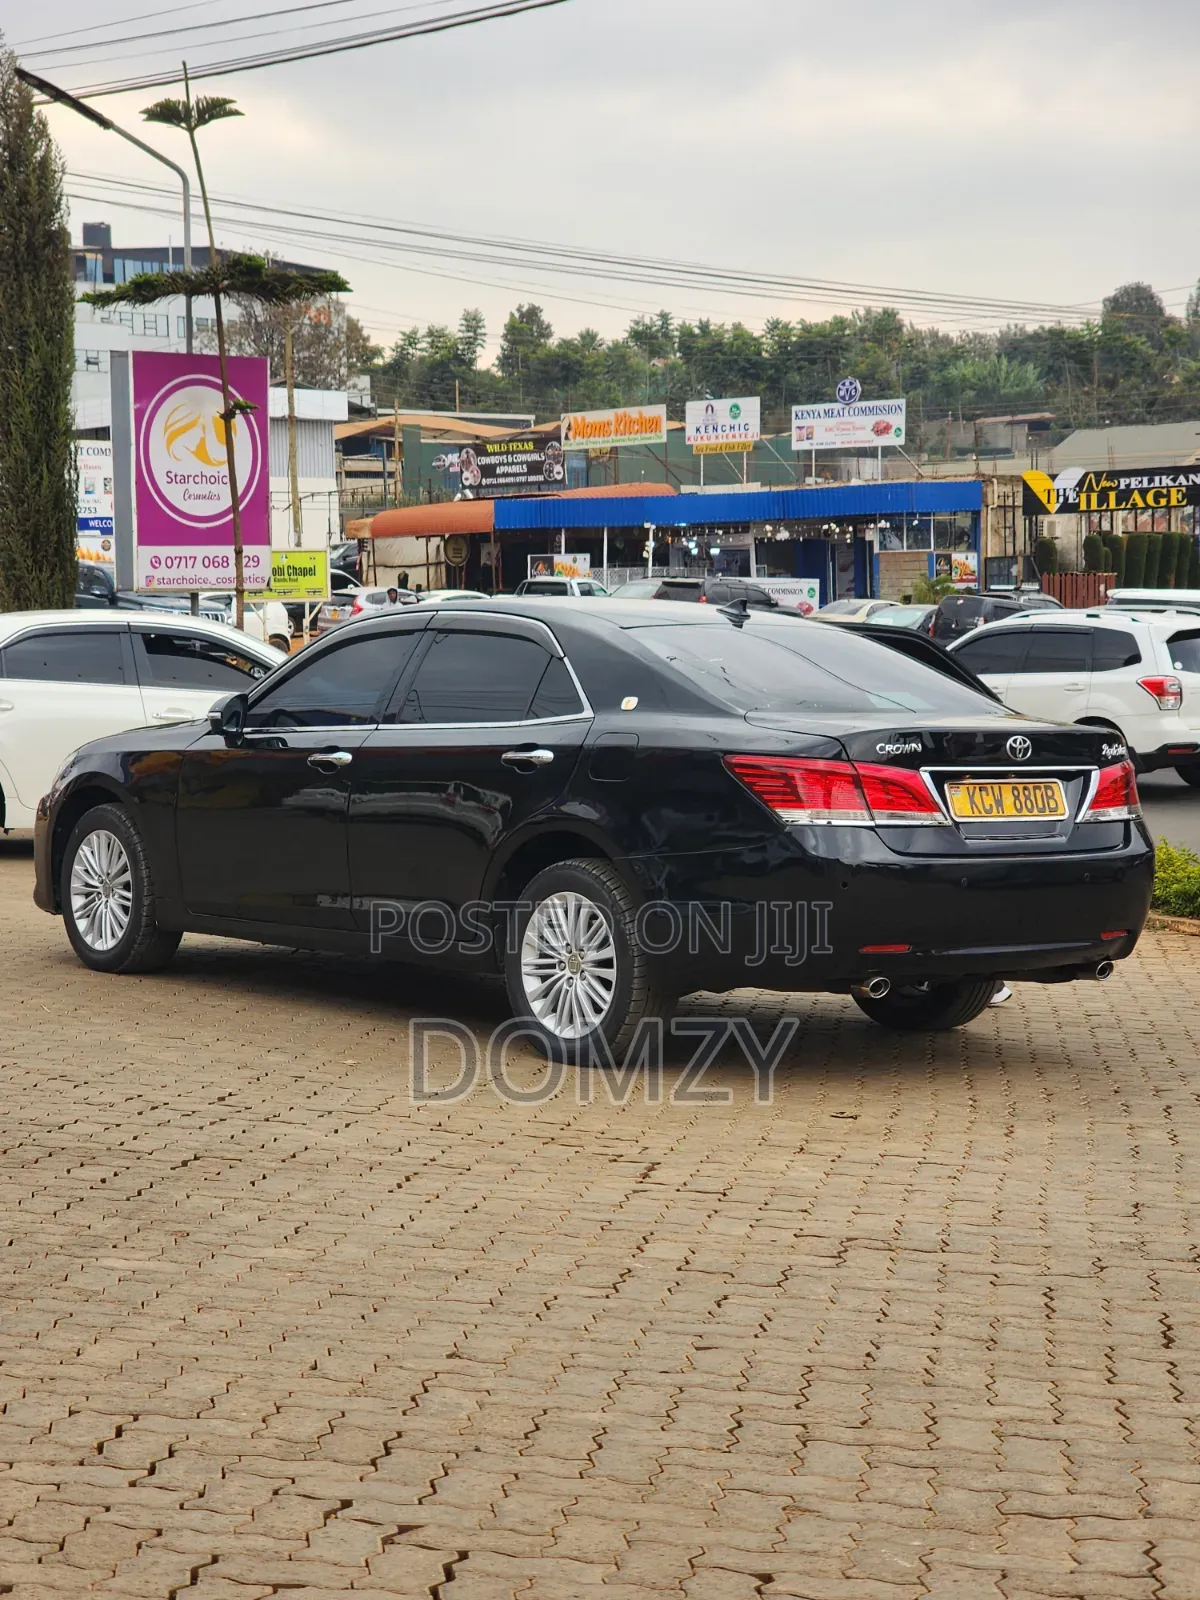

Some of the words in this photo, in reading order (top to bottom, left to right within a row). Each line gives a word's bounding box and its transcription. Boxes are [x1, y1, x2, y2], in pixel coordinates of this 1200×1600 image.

[794, 407, 822, 420] KENYA
[823, 407, 846, 419] MEAT
[848, 403, 903, 417] COMMISSION
[572, 415, 612, 440] Moms
[613, 409, 662, 435] Kitchen
[695, 422, 750, 434] KENCHIC
[687, 435, 711, 443] KUKU
[714, 431, 759, 441] KIENYEJI
[486, 443, 507, 453] WILD
[508, 441, 534, 450] TEXAS
[705, 444, 718, 452] Food
[477, 455, 508, 465] COWBOYS
[513, 452, 545, 462] COWGIRLS
[495, 464, 528, 474] APPARELS
[1083, 472, 1118, 492] New
[1119, 473, 1200, 490] PELIKAN
[183, 488, 221, 501] Cosmetics
[164, 555, 198, 569] 0717
[201, 555, 230, 569] 068
[286, 564, 316, 578] Chapel
[876, 743, 922, 754] CROWN
[966, 785, 1005, 815] KCW
[1011, 784, 1059, 814] 880B
